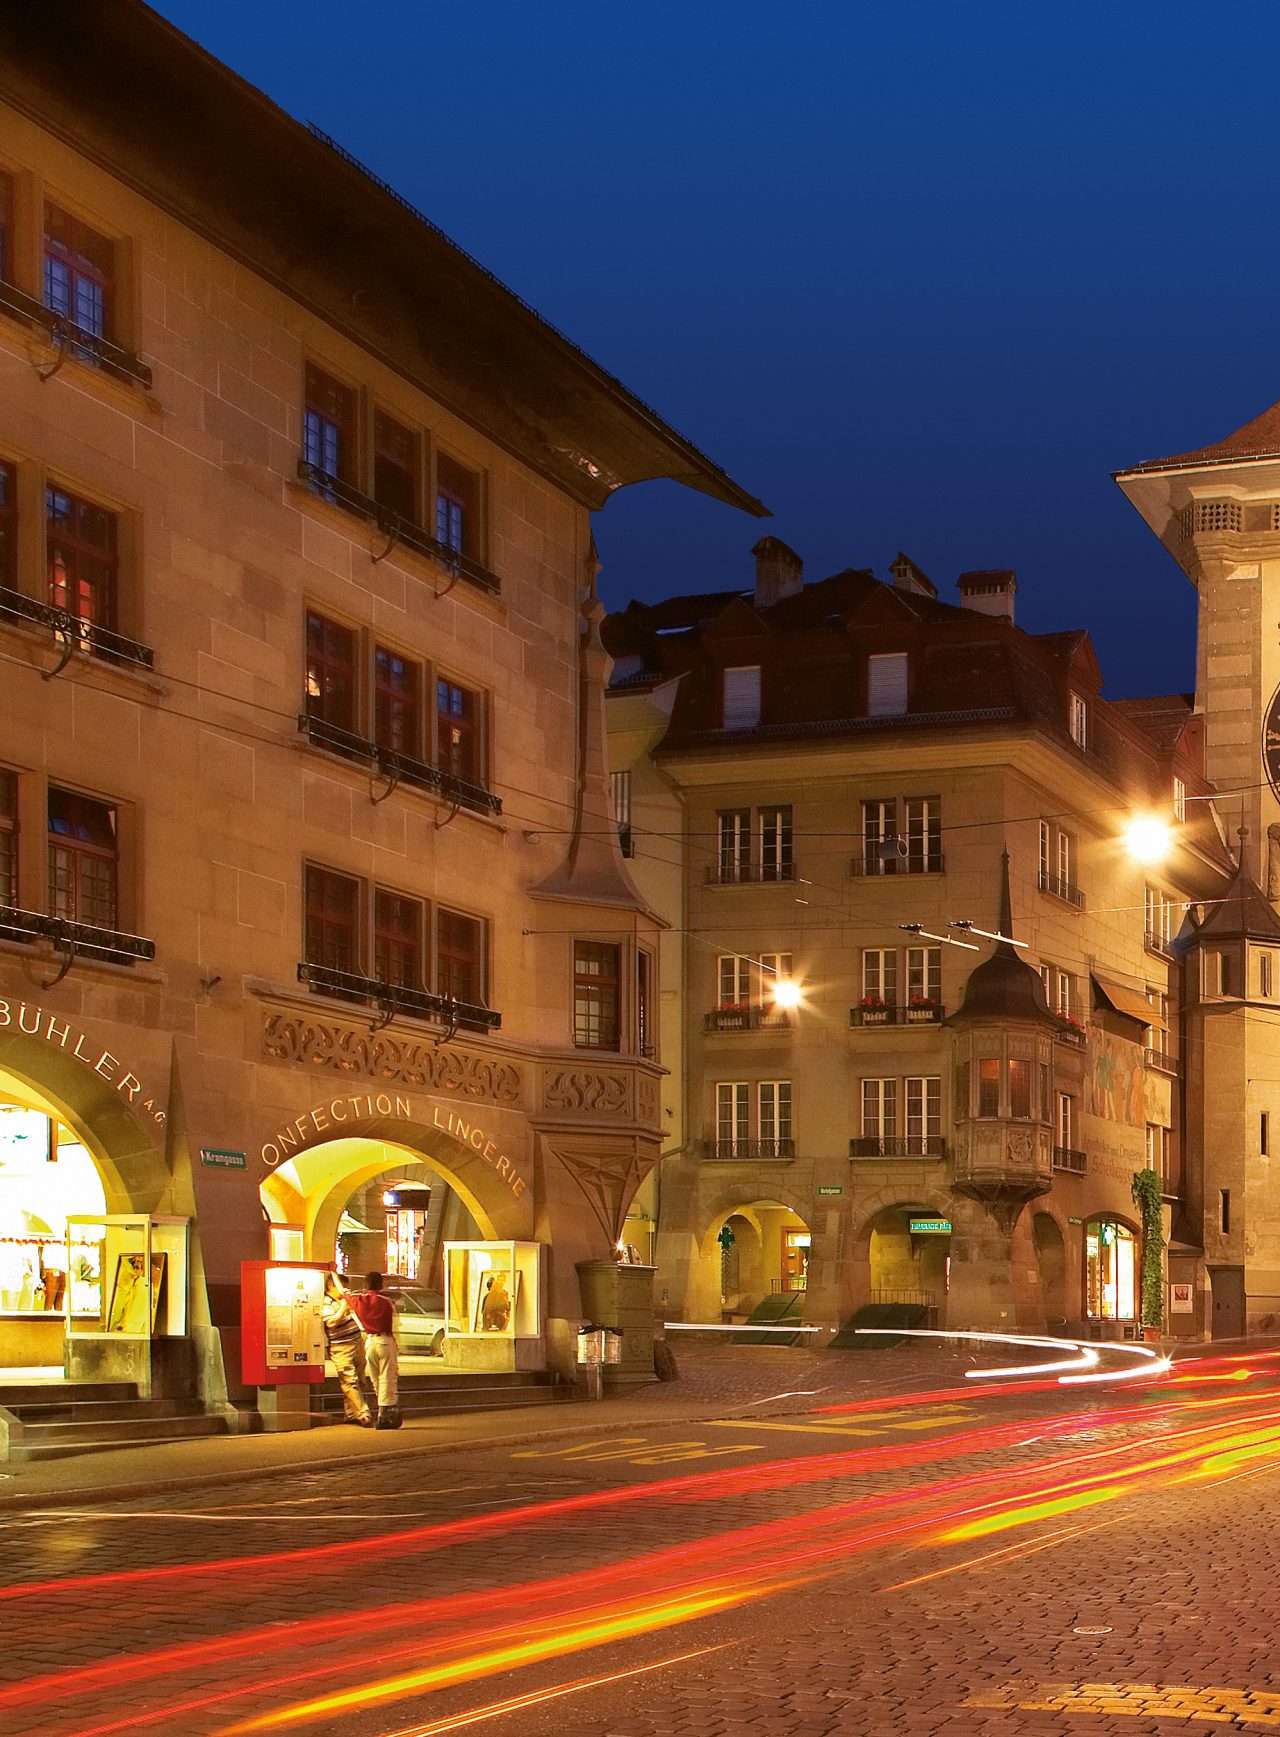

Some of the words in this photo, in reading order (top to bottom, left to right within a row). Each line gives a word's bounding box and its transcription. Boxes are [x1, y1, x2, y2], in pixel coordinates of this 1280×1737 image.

[0, 1000, 141, 1103] BÜHLER
[261, 1094, 411, 1167] ONFECTION
[433, 1107, 527, 1197] LINGERIE
